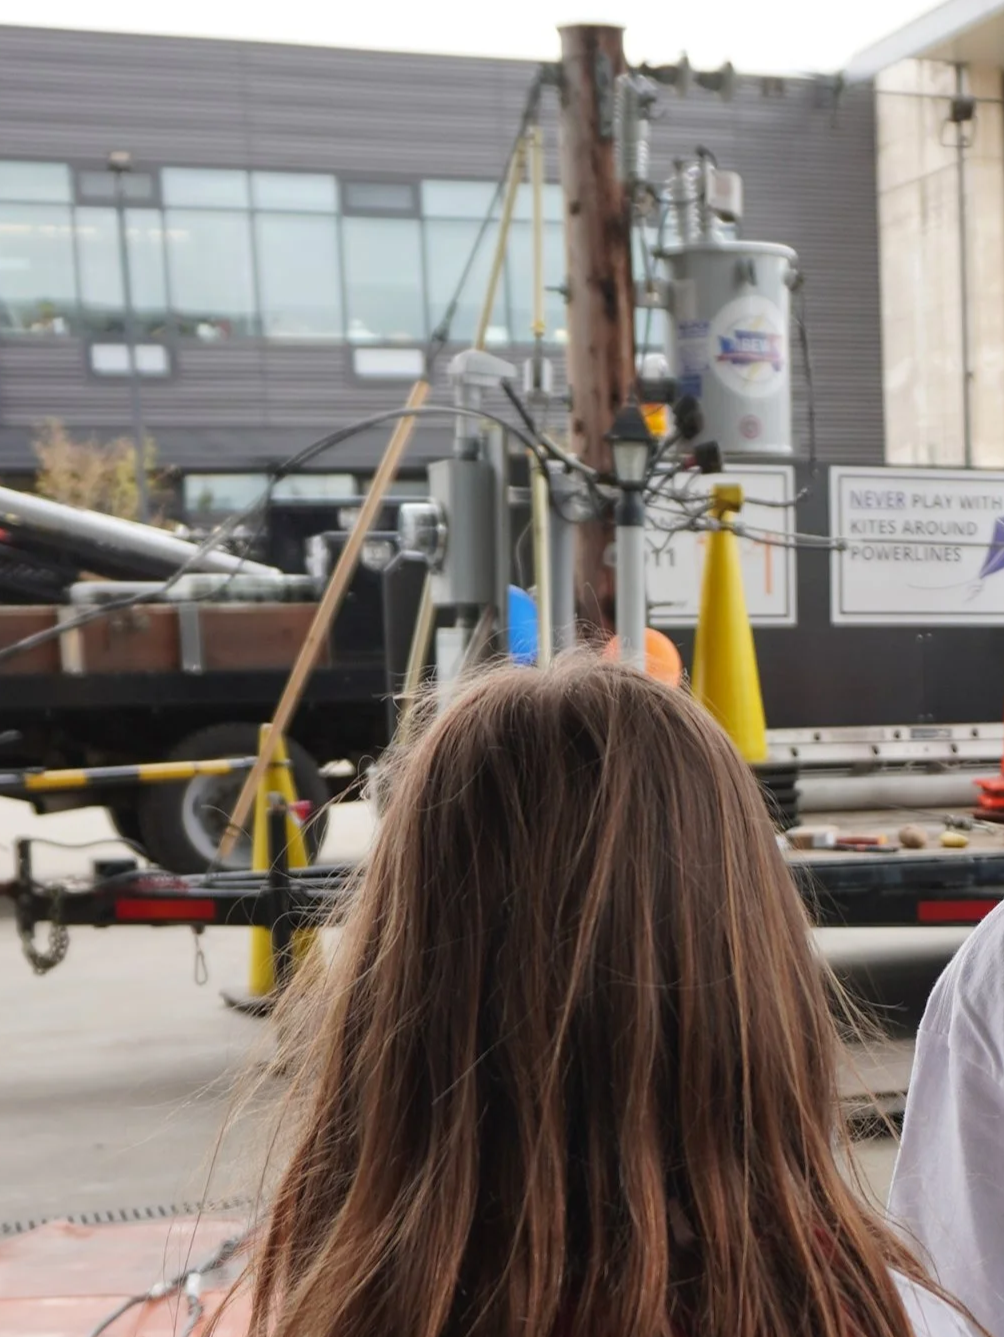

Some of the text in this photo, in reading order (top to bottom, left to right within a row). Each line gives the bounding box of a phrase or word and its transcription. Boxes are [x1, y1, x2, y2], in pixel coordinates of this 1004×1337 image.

[850, 490, 1003, 510] NEVER PLAY WITH
[850, 519, 978, 536] KITES AROUND
[850, 545, 962, 562] POWERLINES
